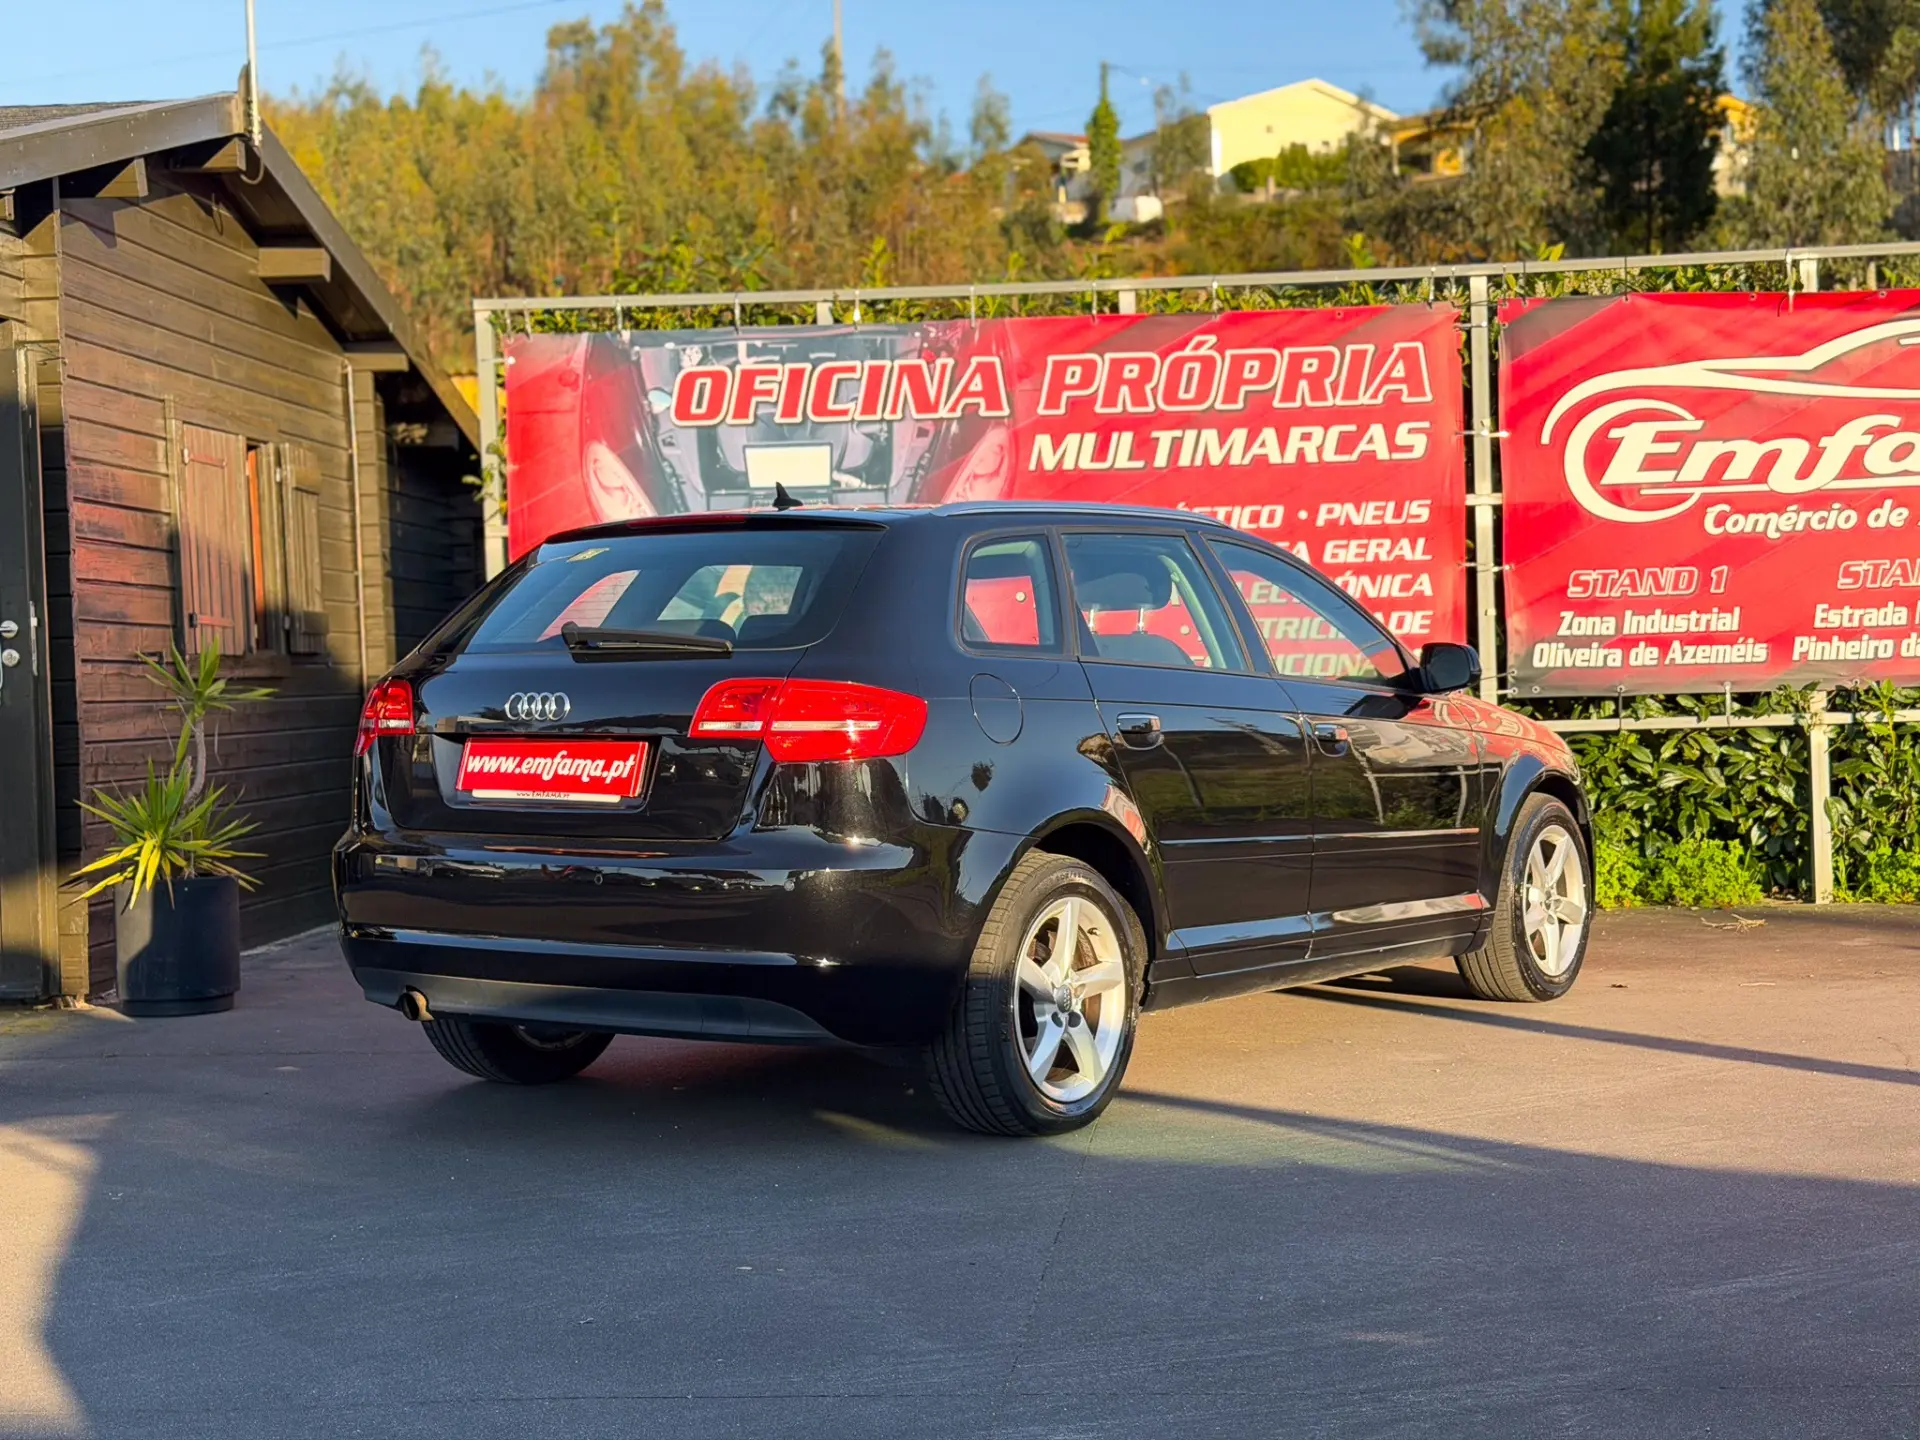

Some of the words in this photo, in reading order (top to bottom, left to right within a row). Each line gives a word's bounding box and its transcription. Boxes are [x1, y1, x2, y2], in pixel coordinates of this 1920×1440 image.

[670, 355, 1010, 426] OFICINA
[1037, 335, 1433, 416] PRÓPRIA
[1028, 422, 1431, 472] MULTIMARCAS
[1315, 500, 1431, 527] PNEUS
[1704, 503, 1858, 540] Comércio
[1867, 499, 1910, 528] de
[1322, 537, 1432, 564] GERAL
[1567, 566, 1699, 598] STAND
[1709, 564, 1729, 594] 1
[1557, 611, 1616, 636] Zona
[1623, 606, 1740, 635] Industrial
[1813, 601, 1908, 629] Estrada
[1532, 642, 1623, 668] Oliveira
[1629, 642, 1659, 666] de
[1664, 636, 1768, 667] Azeméis
[1792, 634, 1894, 661] Pinheiro
[466, 750, 636, 783] www.emfama.pt
